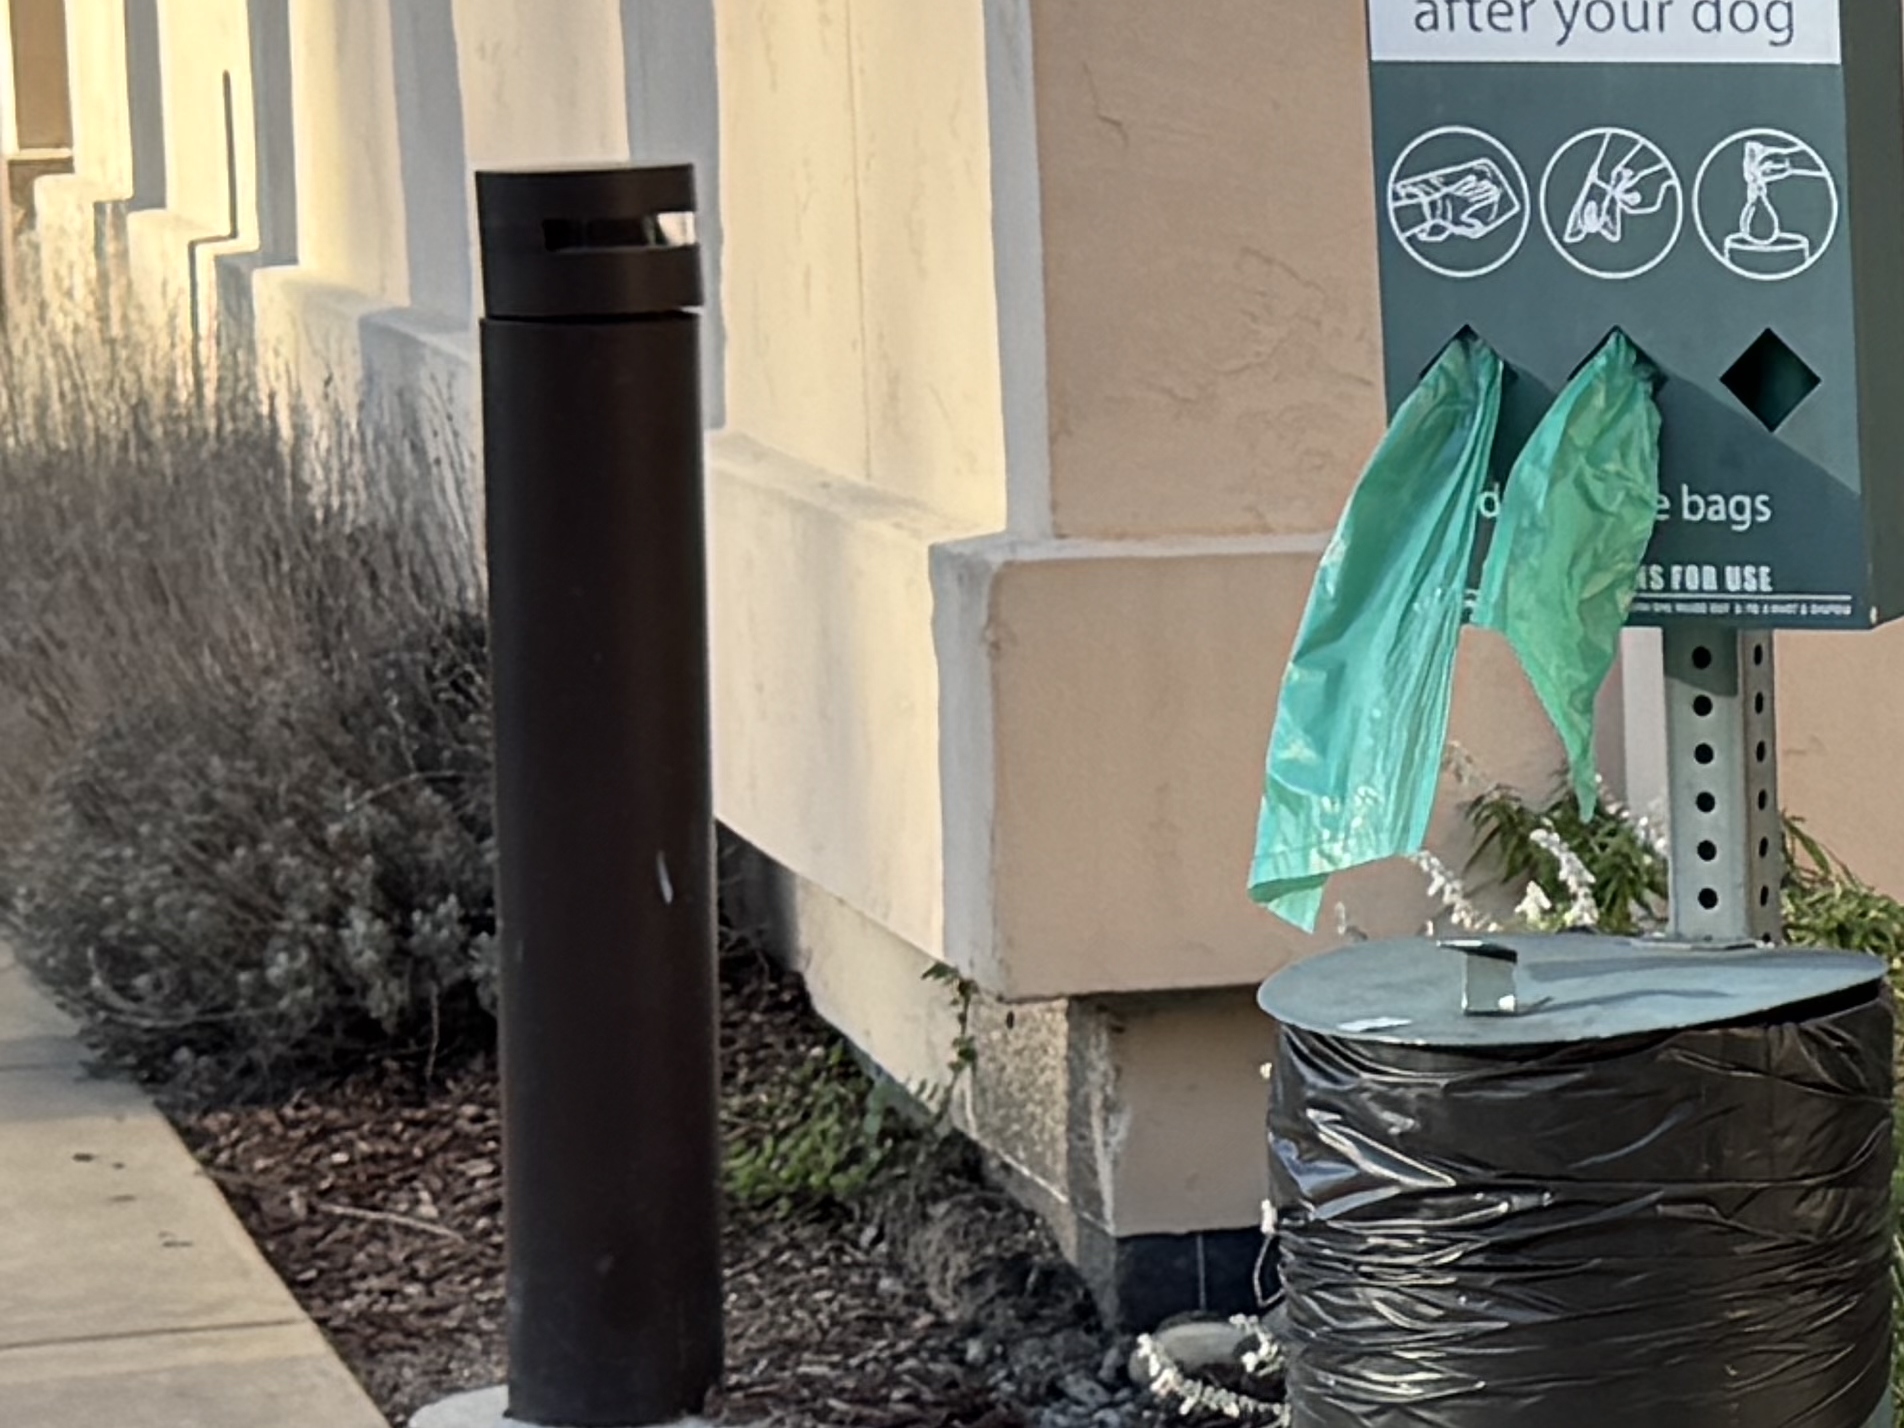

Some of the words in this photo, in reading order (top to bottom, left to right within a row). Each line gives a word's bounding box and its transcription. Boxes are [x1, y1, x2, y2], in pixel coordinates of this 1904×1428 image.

[1681, 483, 1772, 532] bags
[1670, 564, 1719, 591] FOR
[1724, 565, 1774, 593] USE
